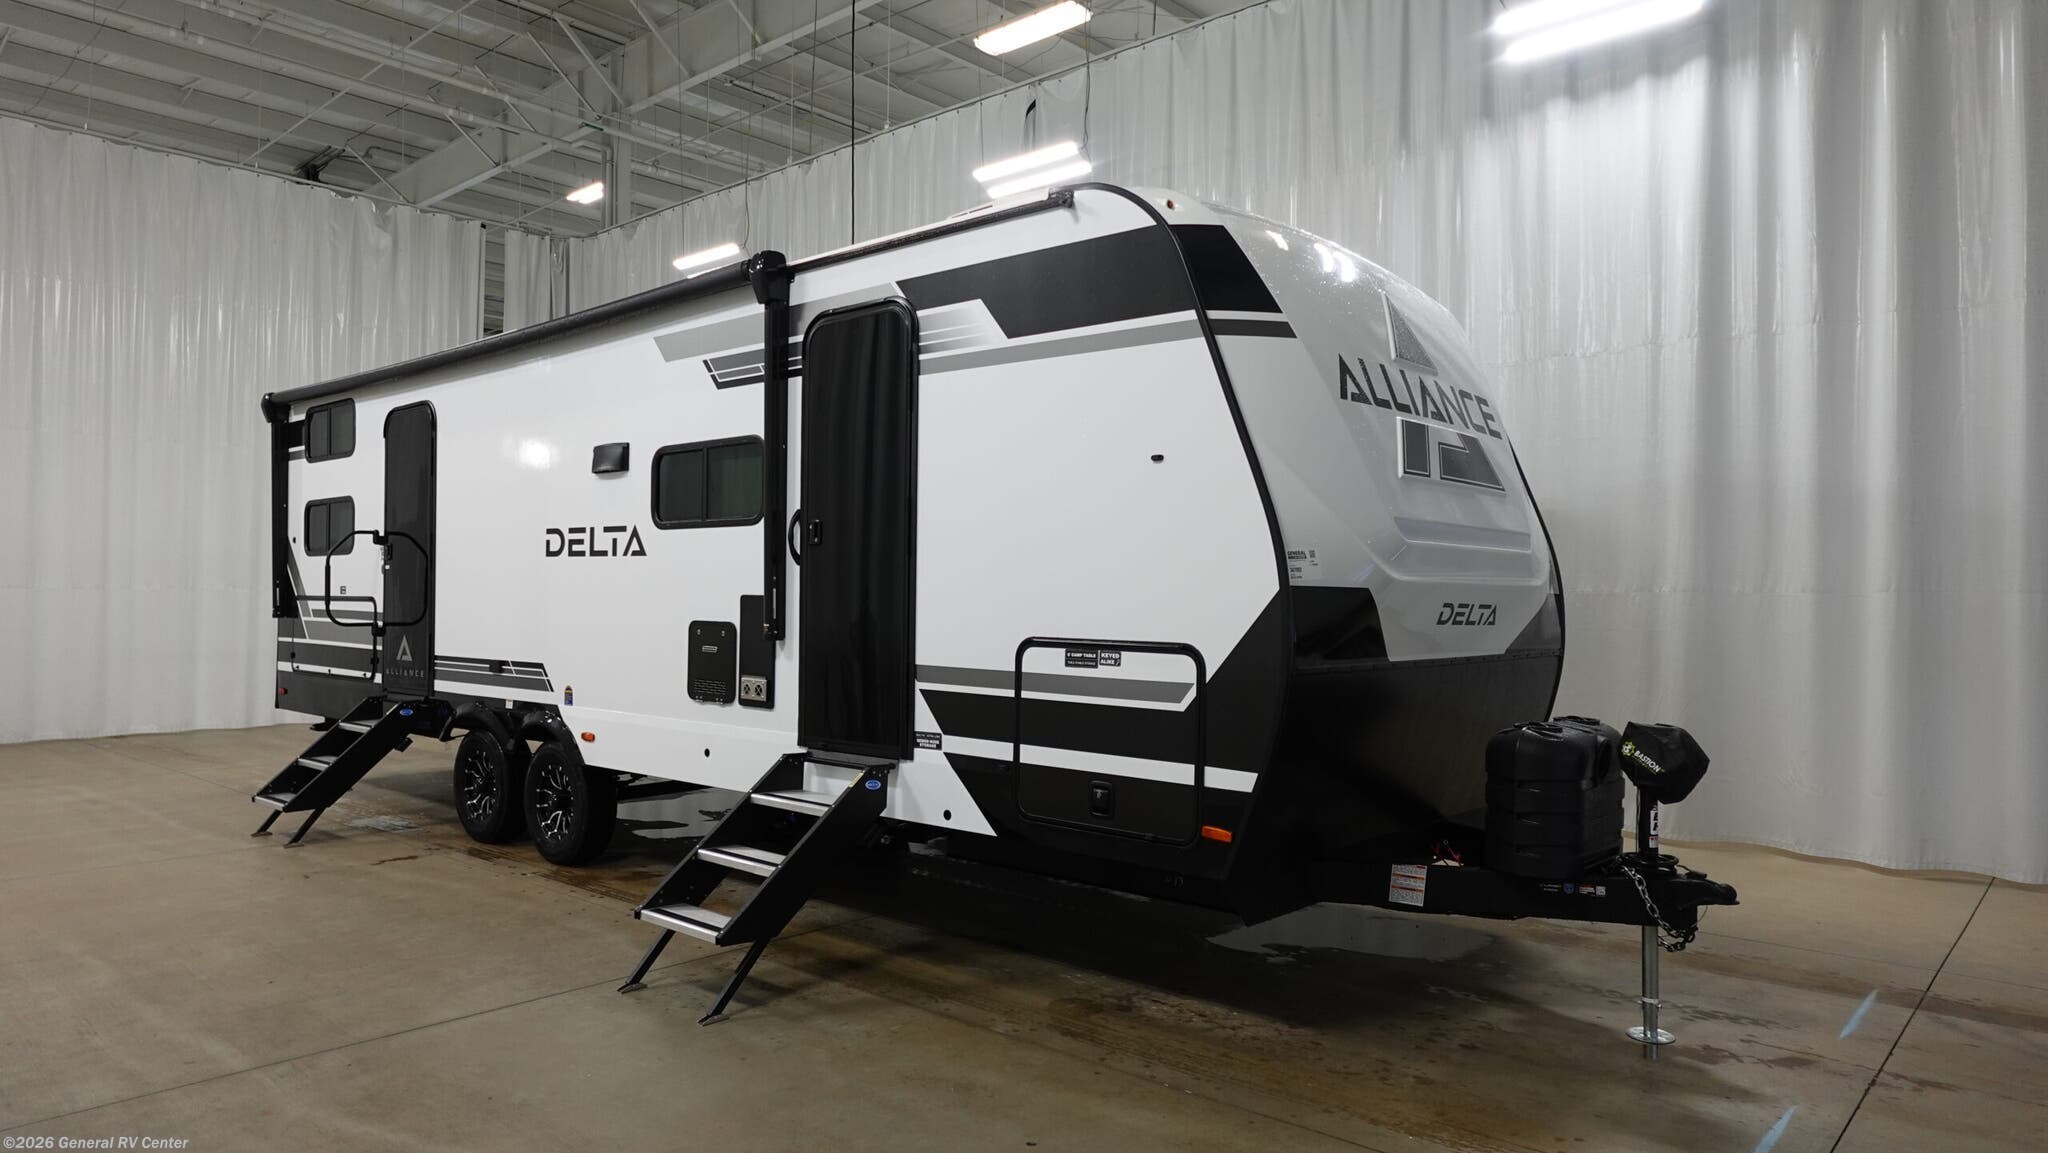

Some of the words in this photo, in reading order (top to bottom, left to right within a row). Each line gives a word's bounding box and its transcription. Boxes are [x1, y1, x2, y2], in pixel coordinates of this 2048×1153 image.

[1339, 354, 1503, 440] ALLIANCE
[545, 524, 648, 557] DELTA
[1436, 603, 1497, 626] DELTA
[386, 667, 425, 678] ALLIANCE
[1633, 750, 1661, 773] BASTION
